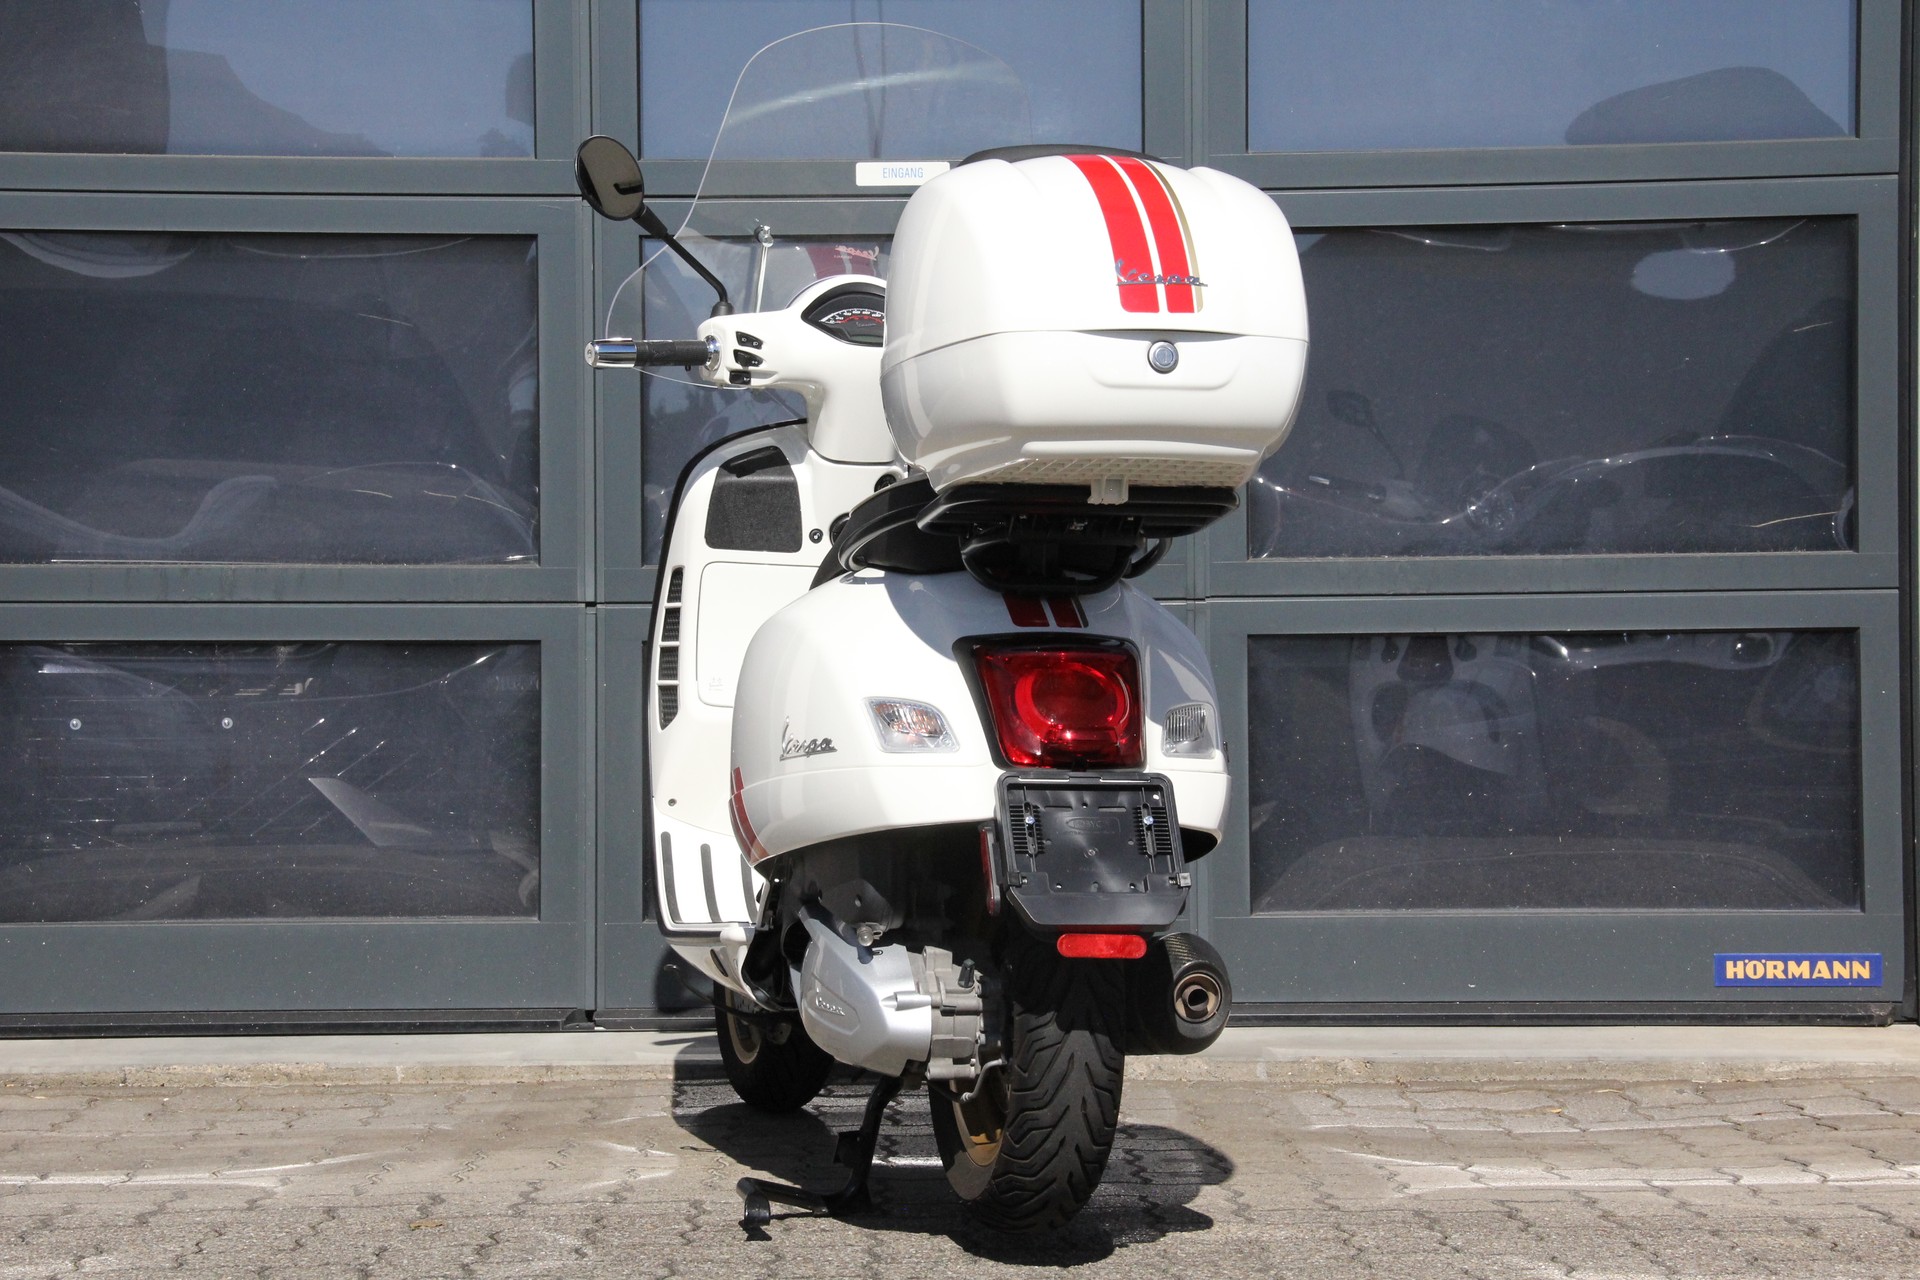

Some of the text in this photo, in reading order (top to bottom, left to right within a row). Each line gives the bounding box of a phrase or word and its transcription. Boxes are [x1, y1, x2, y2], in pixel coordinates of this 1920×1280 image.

[882, 167, 924, 179] EINGANG
[1115, 259, 1208, 287] Vespa
[780, 716, 838, 761] Vespa
[1726, 959, 1870, 980] HÖRMANN
